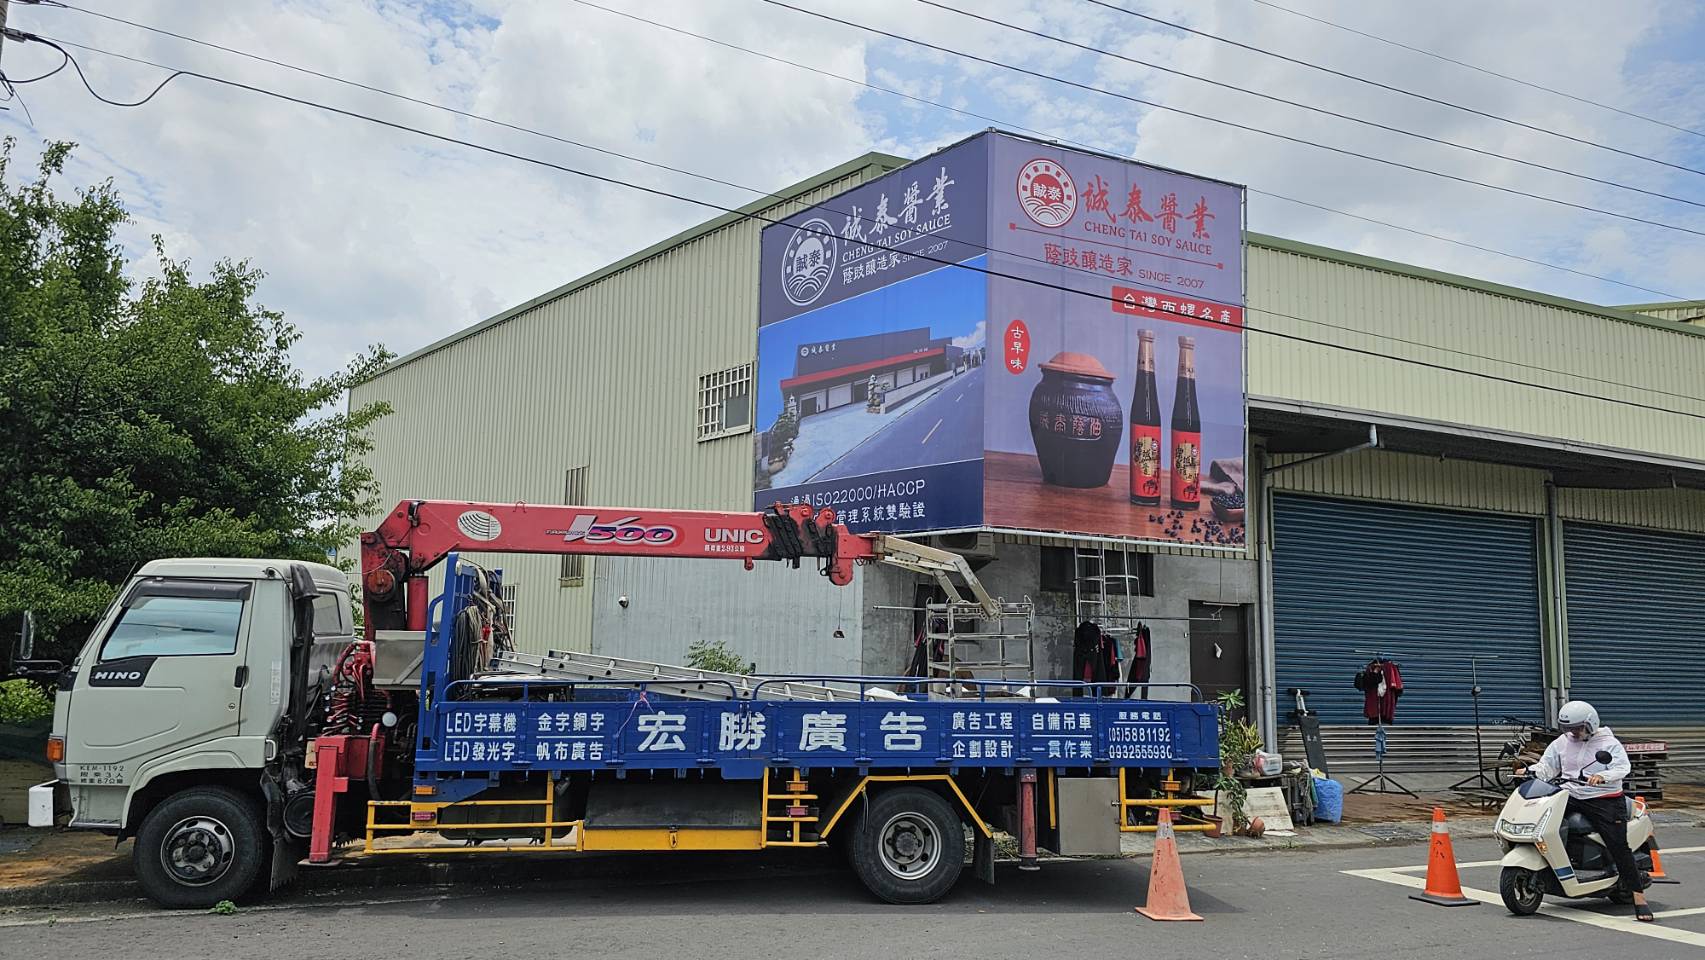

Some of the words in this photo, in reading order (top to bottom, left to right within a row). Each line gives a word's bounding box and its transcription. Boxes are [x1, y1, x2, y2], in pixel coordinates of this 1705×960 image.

[842, 242, 874, 262] CHENG
[877, 236, 892, 250] TAI
[895, 228, 914, 244] SOY
[916, 214, 951, 236] SAUCE
[928, 240, 949, 254] 2007
[1084, 221, 1126, 238] CHENG
[1129, 229, 1147, 241] TAI
[1151, 234, 1172, 247] SOY
[1176, 239, 1213, 255] SAUCE
[1138, 269, 1172, 283] SINCE
[1177, 276, 1205, 289] 2007
[1010, 325, 1025, 370] 古早味
[813, 501, 926, 525] 管理系統雙驗證
[704, 528, 764, 544] UNIC
[94, 671, 142, 680] HINO
[446, 712, 517, 733] LED字幕機
[952, 711, 1013, 730] 廣告工程
[1032, 712, 1092, 731] 自備吊車
[637, 710, 927, 752] 宏勝廣告
[1108, 727, 1171, 742] (05)5881192
[445, 741, 515, 761] LED發光字
[536, 741, 604, 761] 帆布廣告
[952, 740, 1014, 758] 企劃設計
[1032, 740, 1093, 758] 一貫作業
